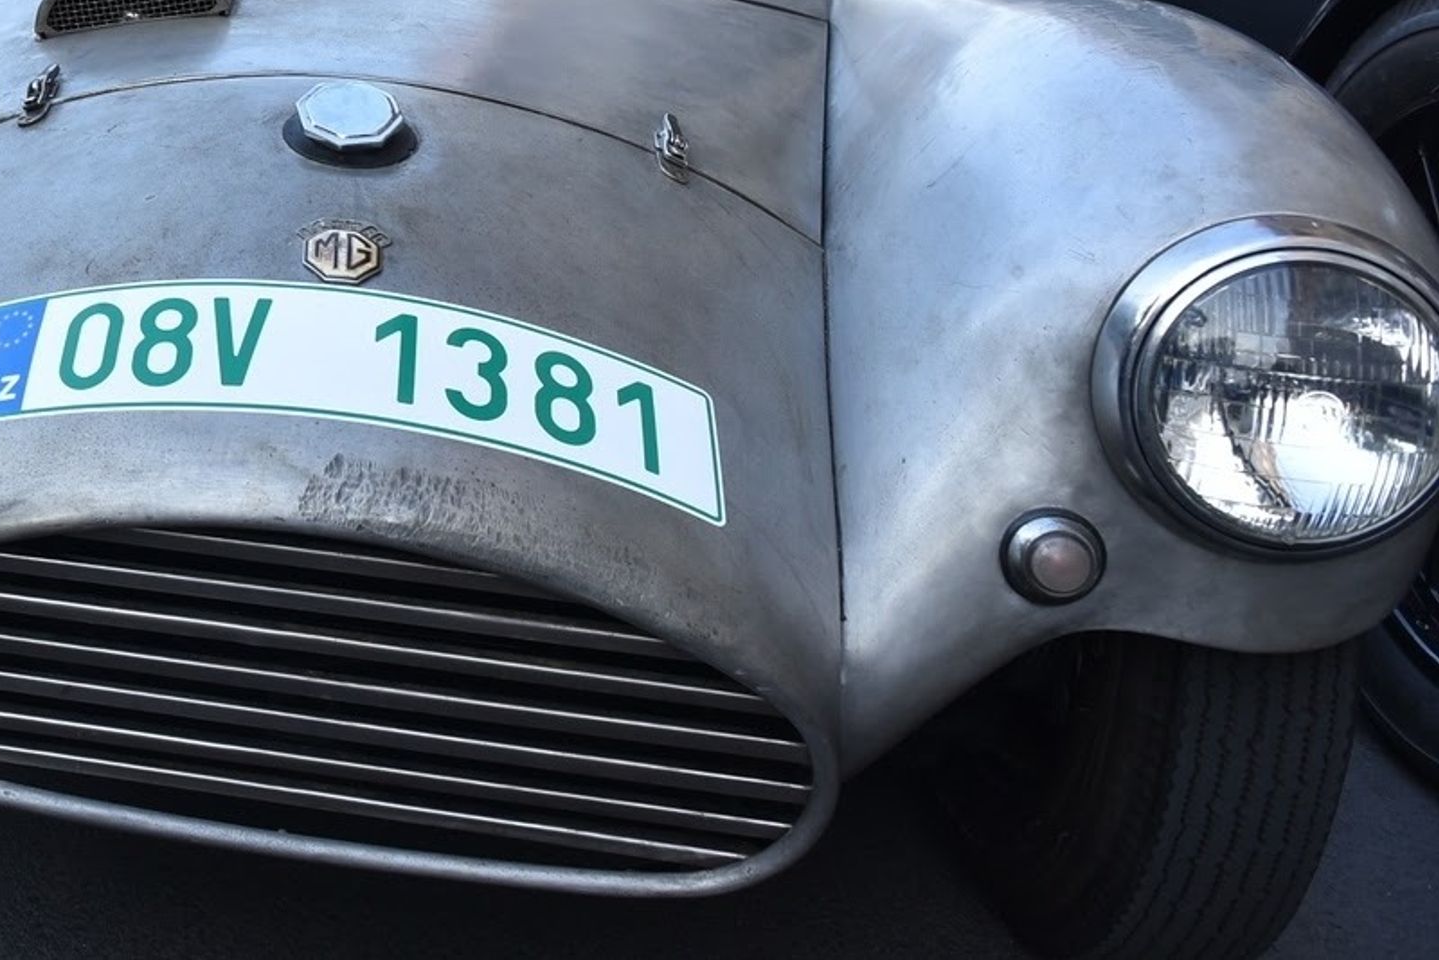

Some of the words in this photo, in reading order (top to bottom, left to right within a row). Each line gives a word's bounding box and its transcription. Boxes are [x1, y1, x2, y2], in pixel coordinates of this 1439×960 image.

[314, 231, 373, 271] MG
[58, 296, 273, 391] 08V
[374, 312, 660, 476] 1381
